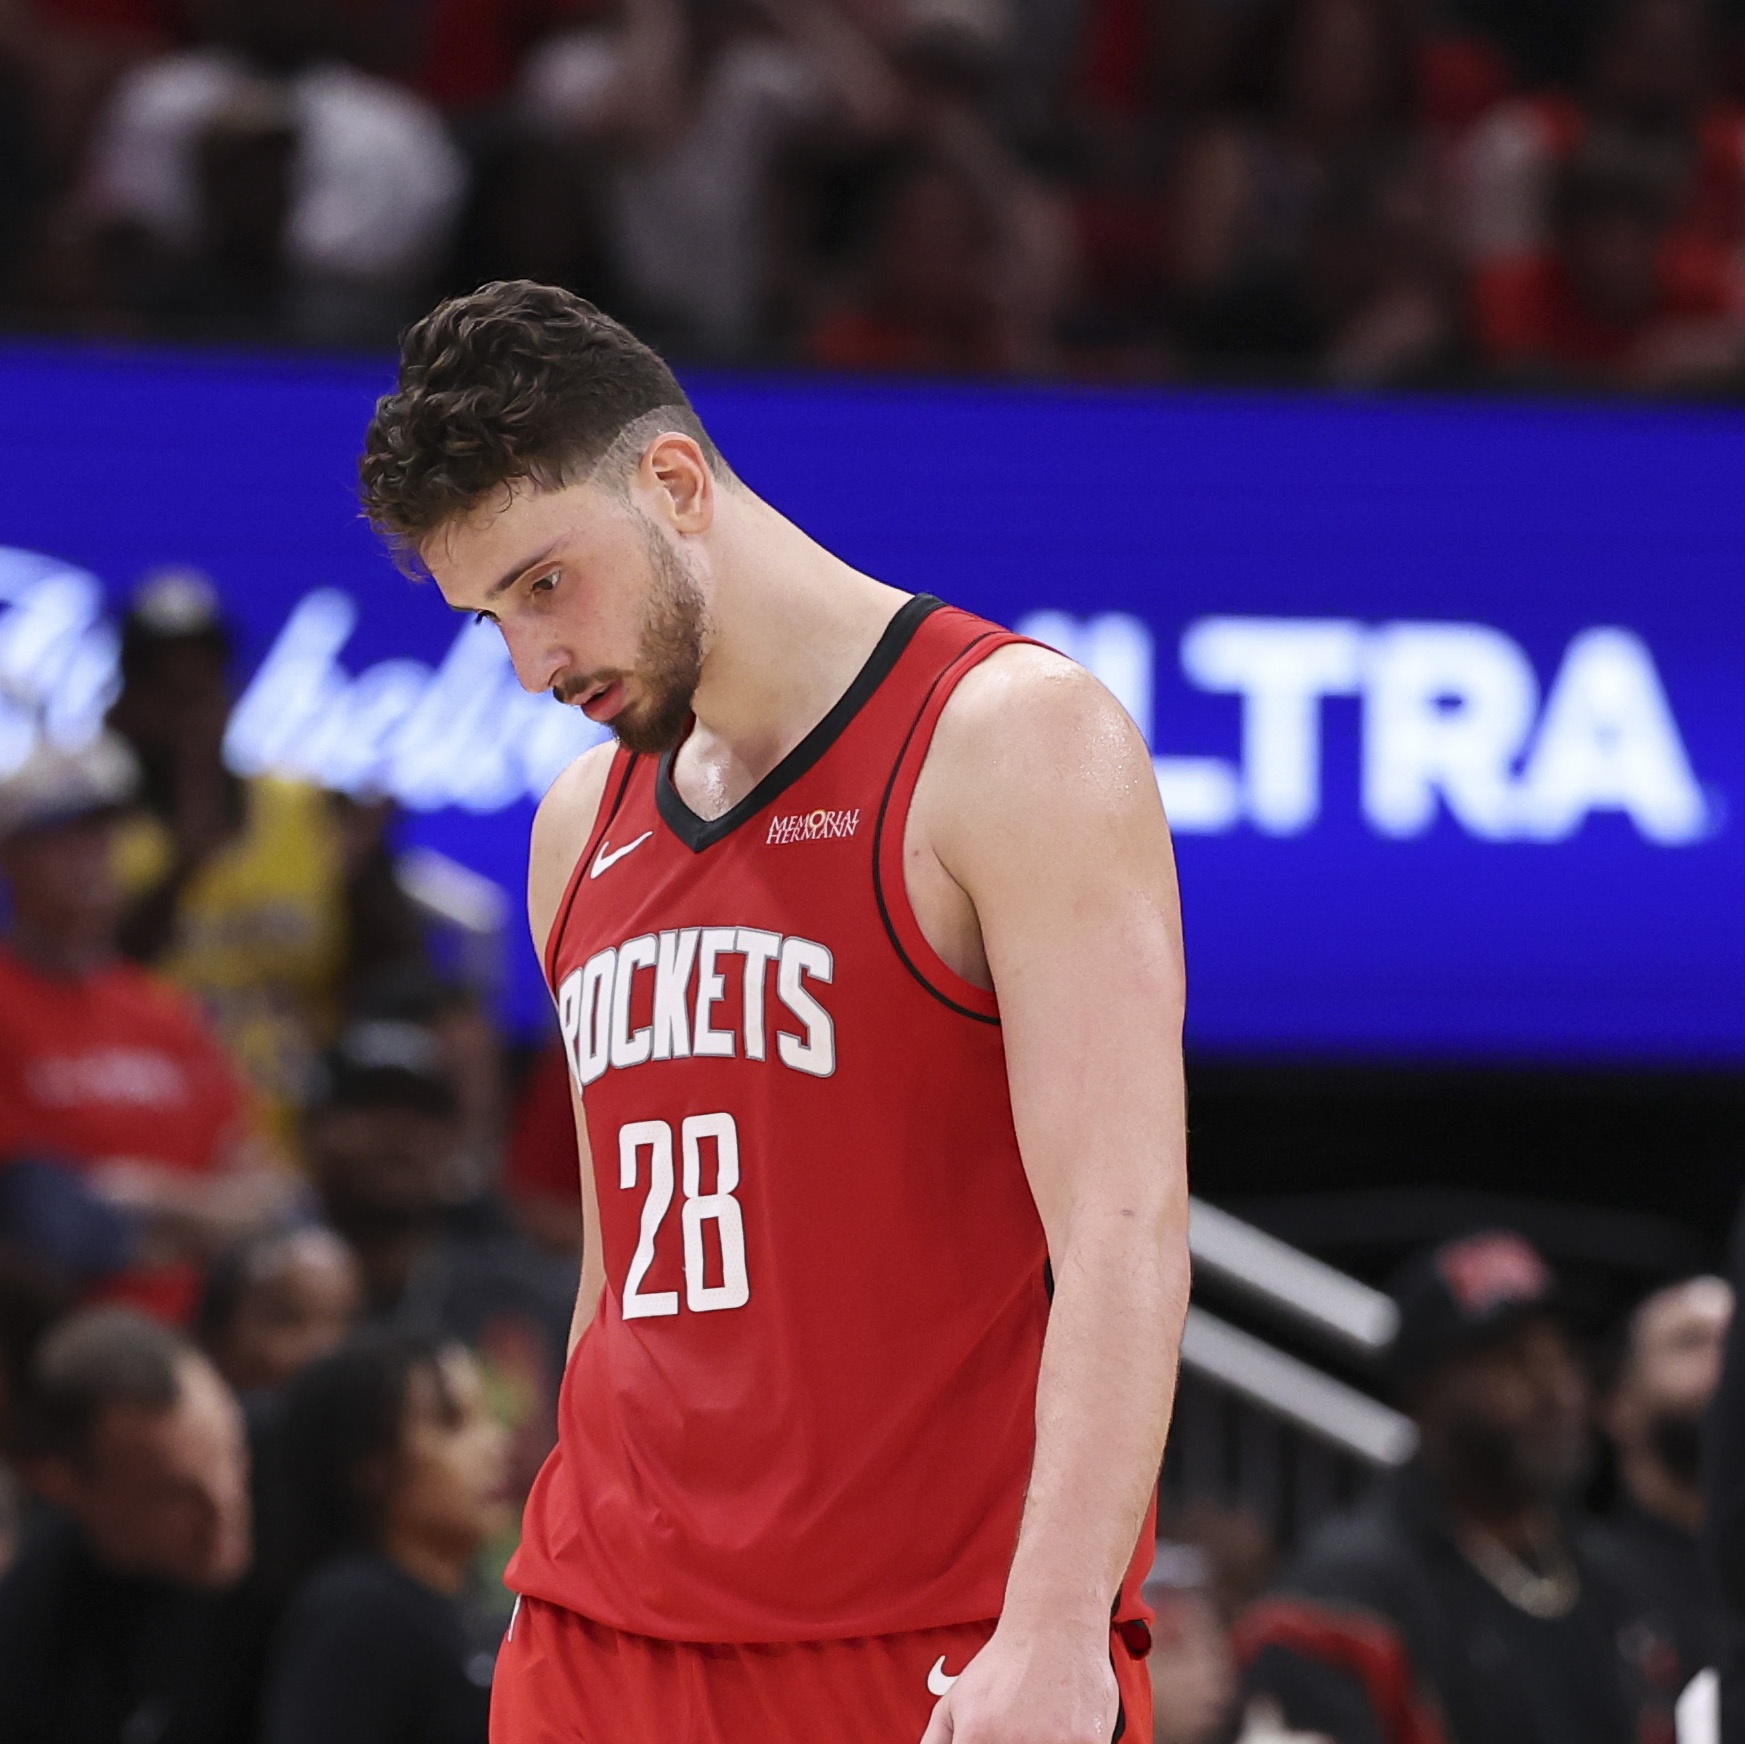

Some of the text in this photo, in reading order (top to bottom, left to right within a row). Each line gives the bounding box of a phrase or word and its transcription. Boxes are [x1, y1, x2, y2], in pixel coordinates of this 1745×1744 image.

[766, 821, 859, 845] HERMANN
[768, 808, 860, 831] MEMORIAL
[558, 925, 836, 1099] ROCKETS
[618, 1111, 750, 1321] 28
